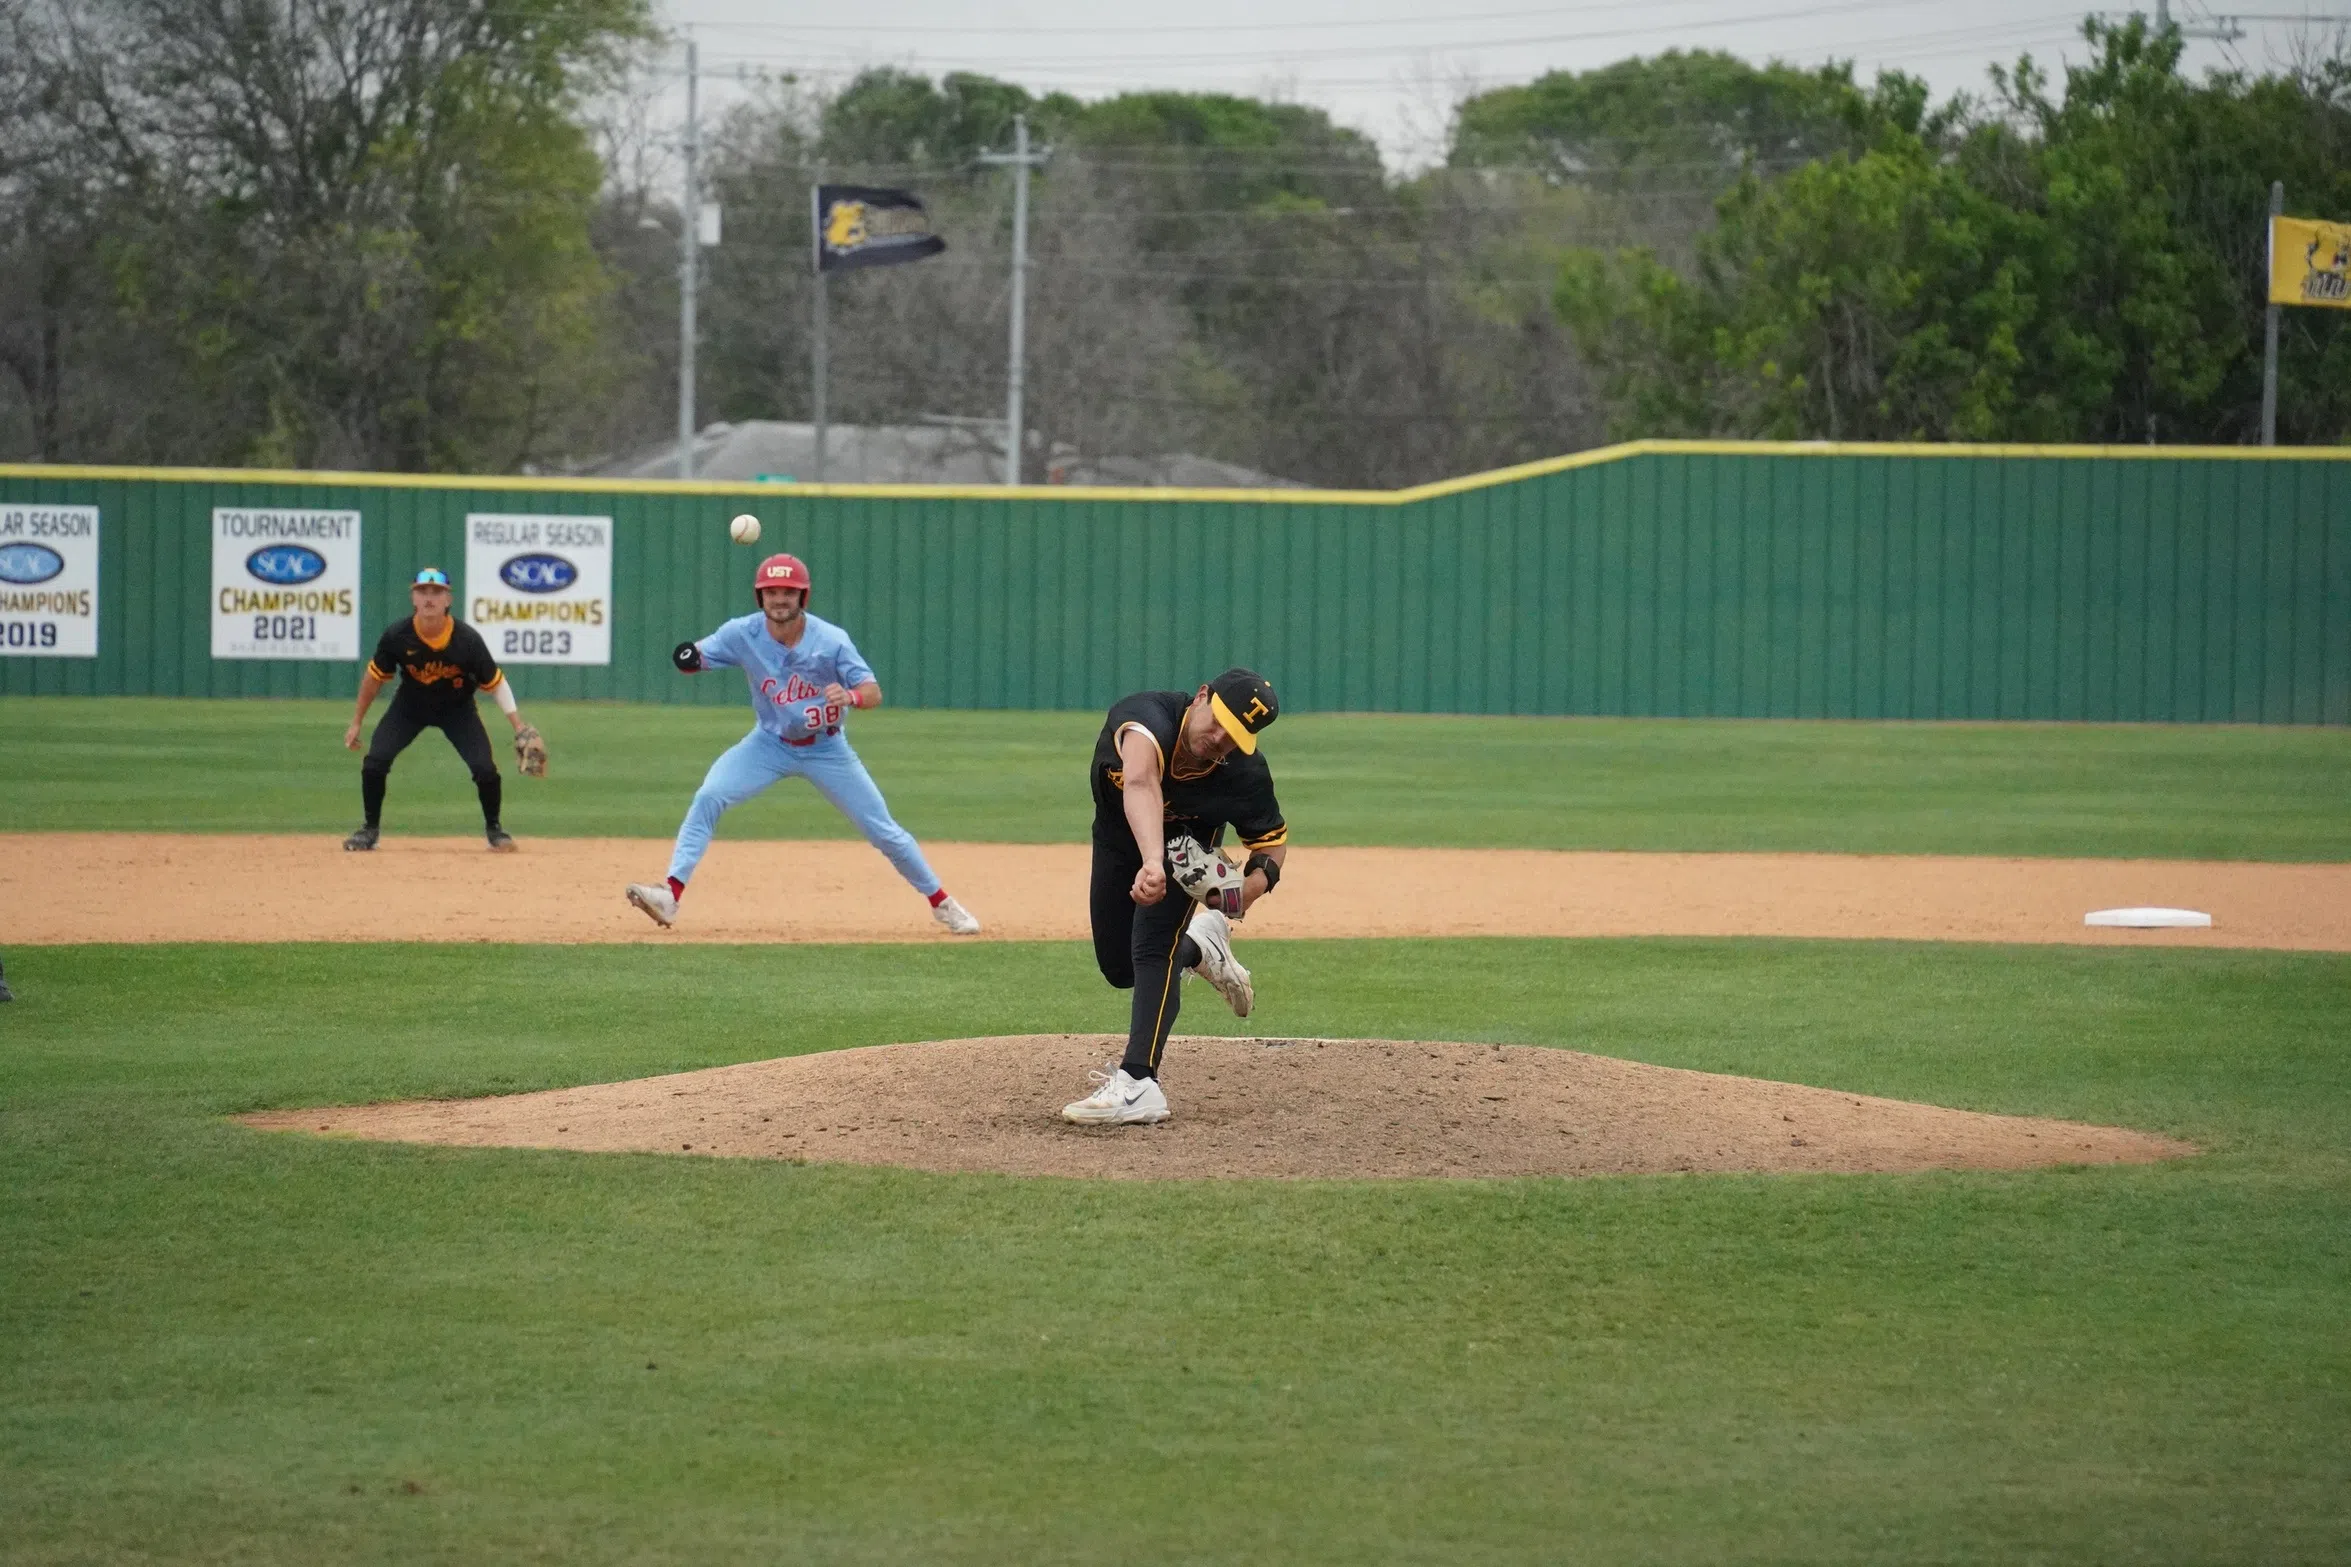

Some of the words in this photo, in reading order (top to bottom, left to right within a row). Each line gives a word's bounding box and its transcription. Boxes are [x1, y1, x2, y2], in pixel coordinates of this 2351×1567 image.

[29, 512, 91, 536] SEASON
[220, 513, 353, 537] TOURNAMENT
[474, 521, 539, 545] REGULAR
[546, 523, 604, 546] SEASON
[767, 566, 793, 578] UST
[219, 588, 352, 616] CHAMPIONS
[473, 598, 603, 626] CHAMPIONS
[254, 616, 316, 640] 2021
[504, 630, 571, 655] 2023
[761, 674, 820, 705] Celts
[804, 703, 841, 729] 38
[1242, 697, 1269, 724] T
